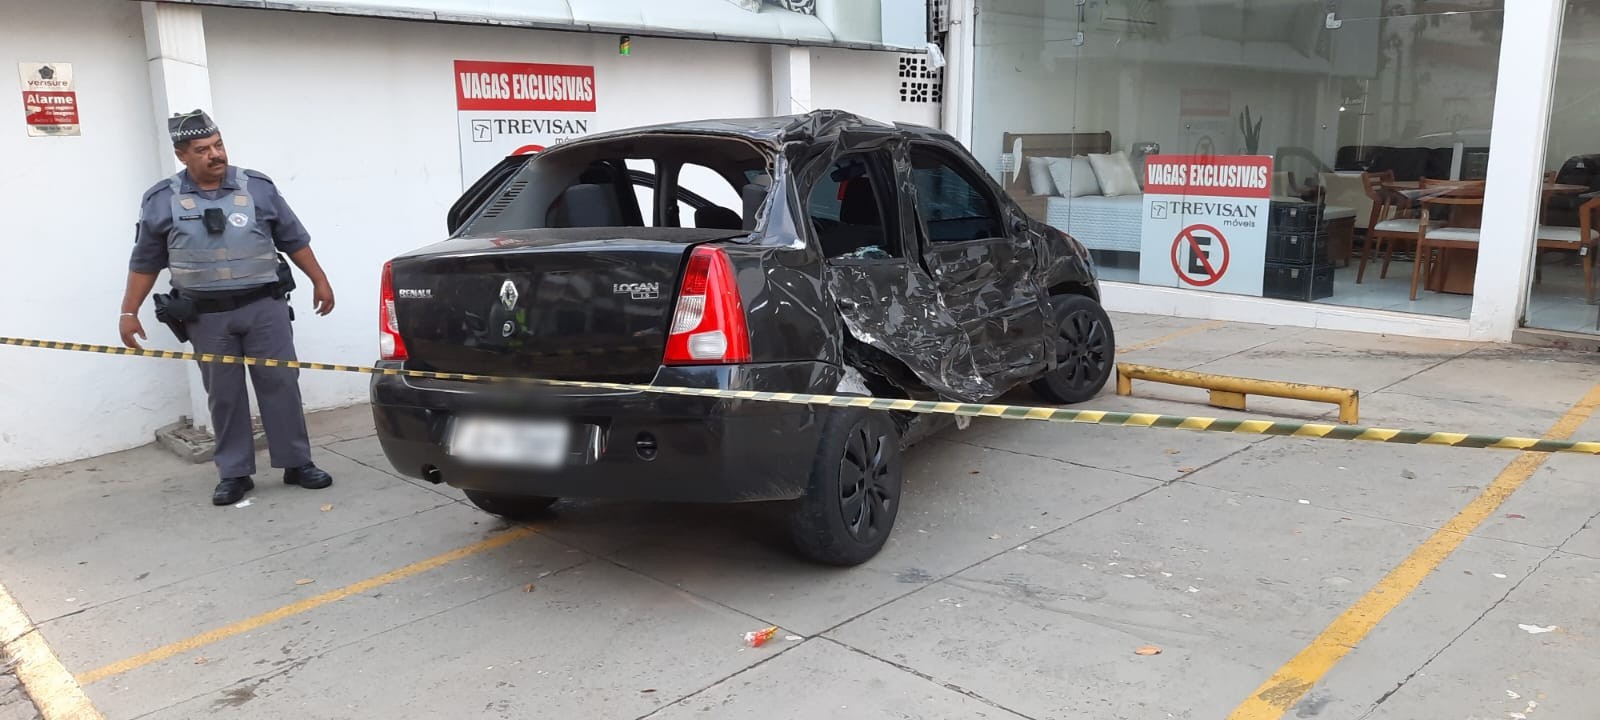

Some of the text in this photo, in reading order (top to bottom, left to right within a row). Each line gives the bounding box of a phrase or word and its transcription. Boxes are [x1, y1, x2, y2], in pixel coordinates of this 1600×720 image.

[460, 72, 593, 102] VAGAS EXCLUSIVAS
[27, 94, 73, 104] Alarme
[493, 119, 588, 134] TREVISAN
[1148, 164, 1268, 189] VAGAS EXCLUSIVAS
[1169, 201, 1258, 218] TREVISAN
[1223, 219, 1256, 228] móveis
[613, 282, 659, 293] LOGAN
